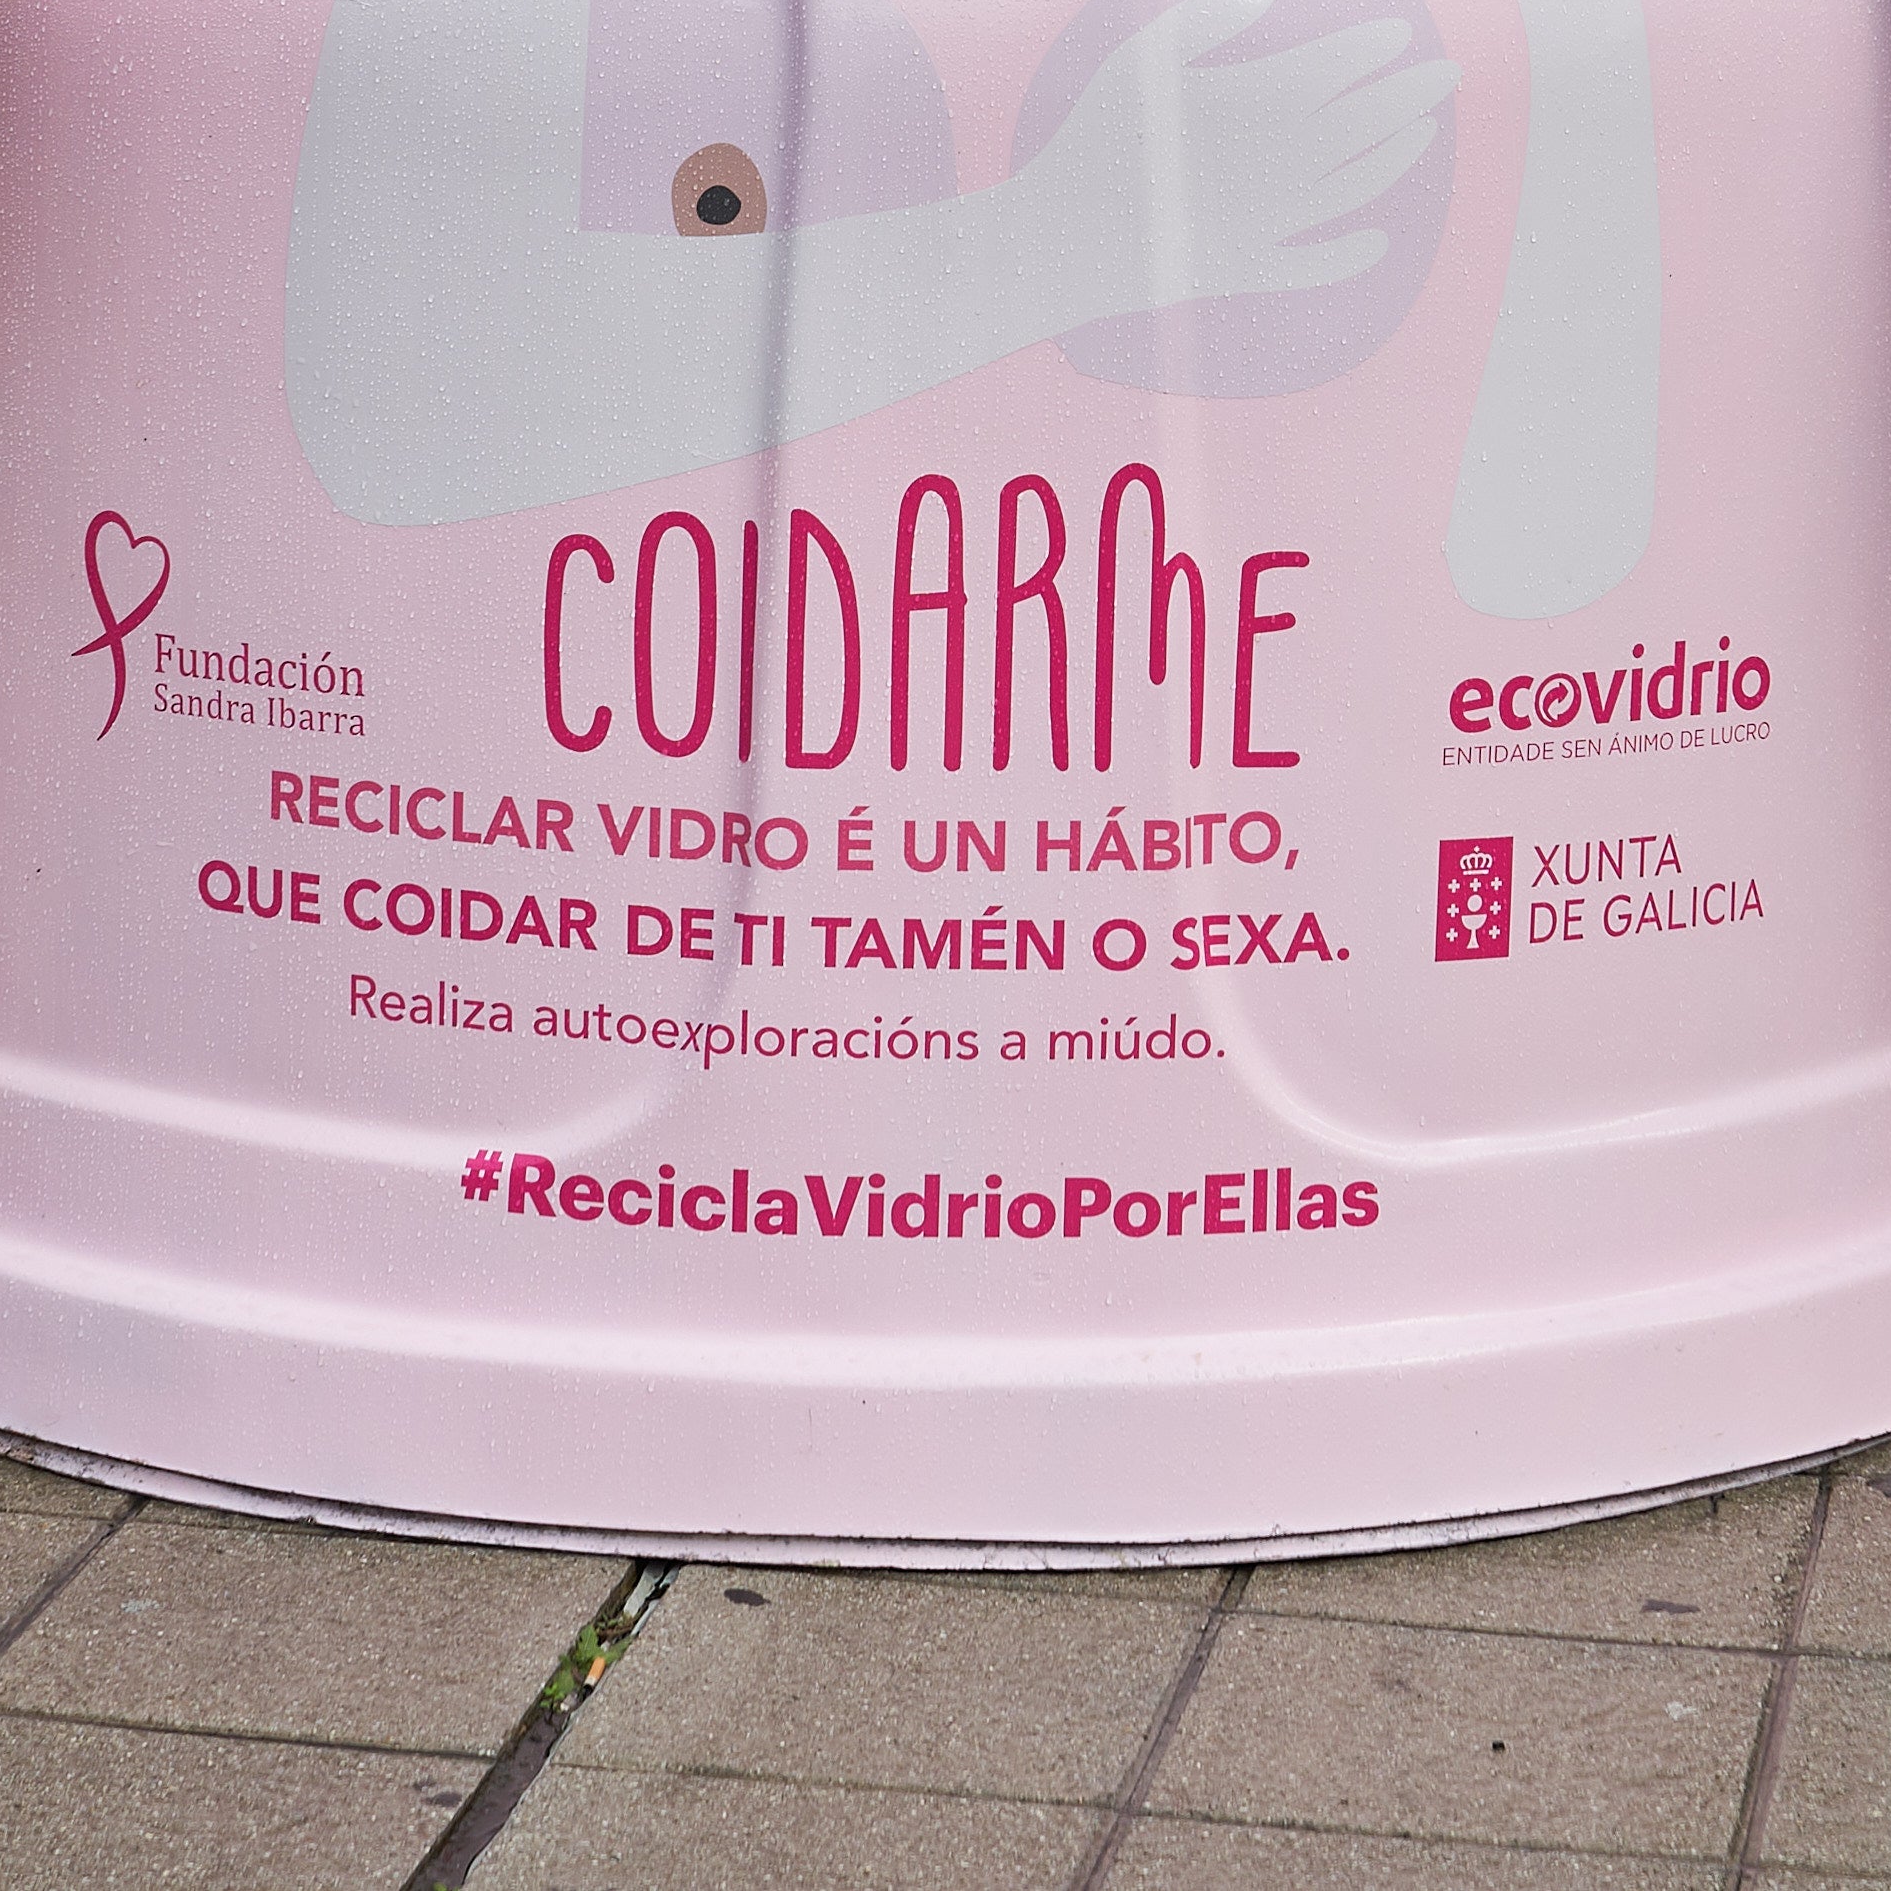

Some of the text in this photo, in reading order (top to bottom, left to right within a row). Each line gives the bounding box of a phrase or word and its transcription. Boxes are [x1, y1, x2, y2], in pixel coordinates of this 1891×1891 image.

[544, 463, 1310, 773] COIDARME
[154, 632, 365, 698] Fundación
[154, 682, 366, 737] Sandra Ibarra
[1449, 635, 1771, 734] ecovidrio
[1442, 721, 1771, 767] ENTIDADE SEN ÁNIMO DE LUCRO
[270, 769, 1300, 872] RECICLAR VIDRO É UN HÁBITO,
[1531, 833, 1682, 888] XUNTA
[197, 859, 1351, 971] QUE COIDAR DE TI TAMÉN O SEXA.
[1529, 878, 1764, 944] DE GALICIA
[349, 973, 1226, 1071] Realiza autoexploracións a miúdo.
[460, 1148, 1381, 1240] #ReciclaVidrioPorEllas
